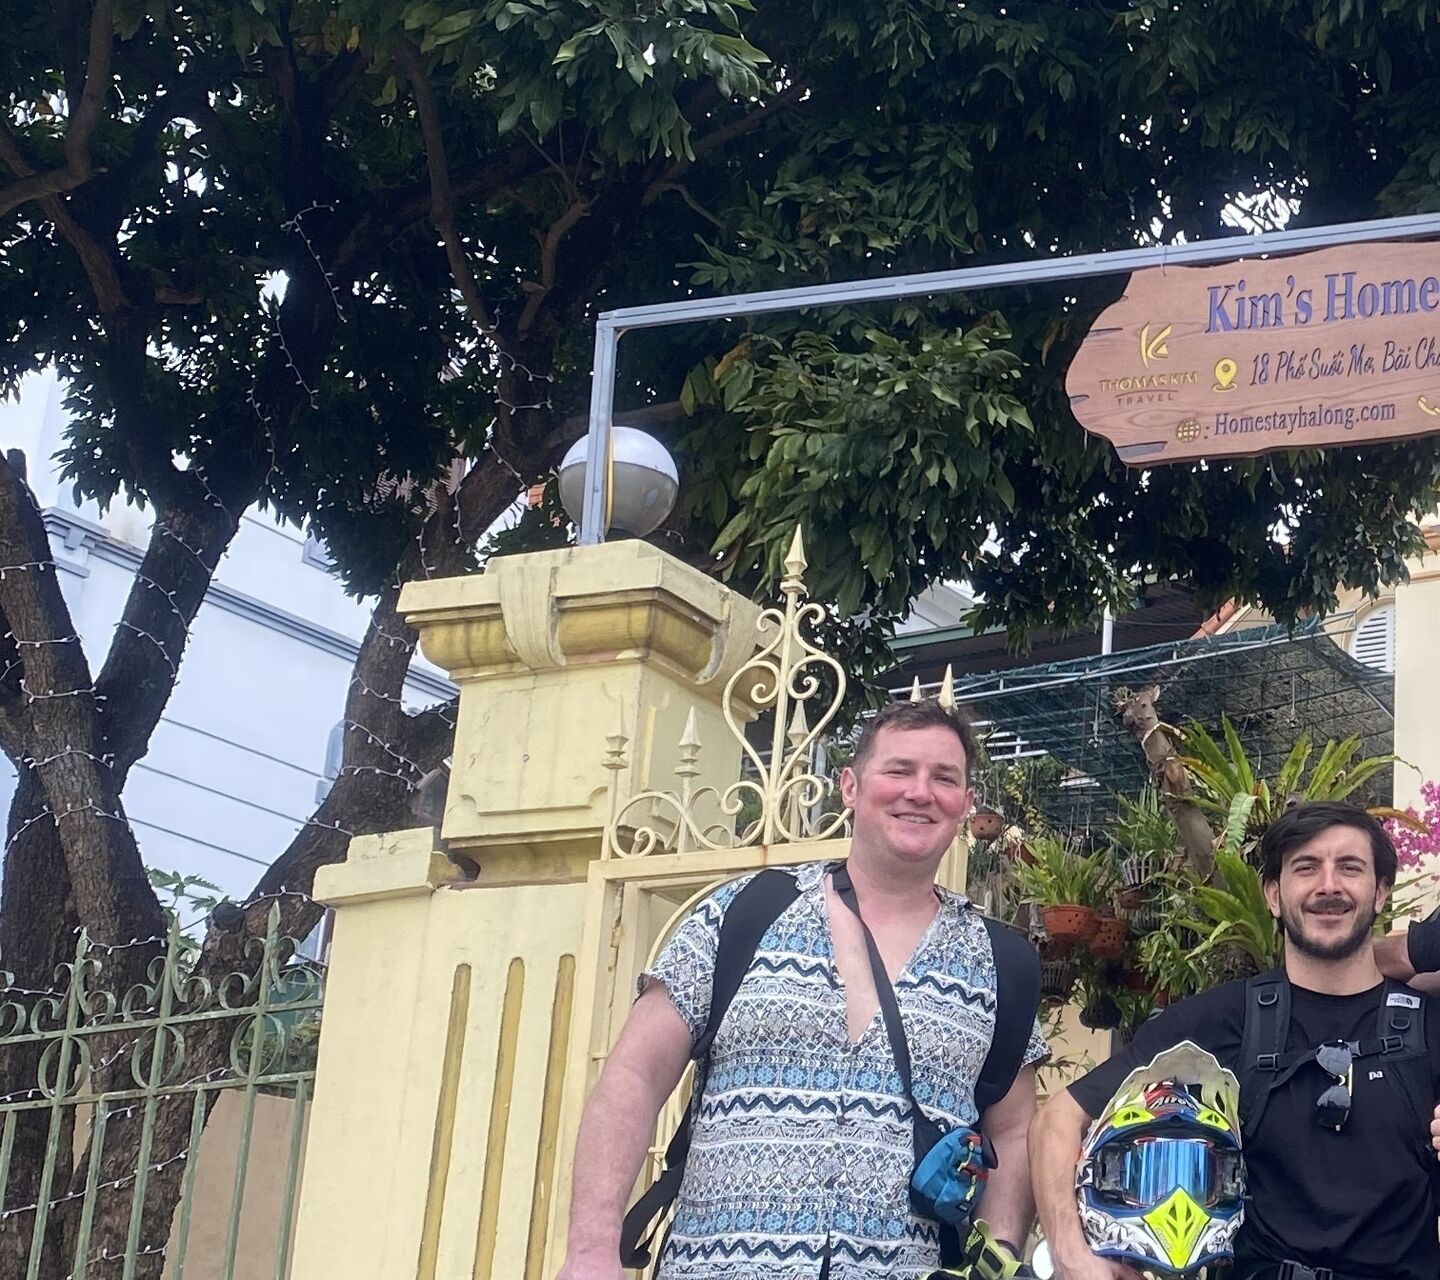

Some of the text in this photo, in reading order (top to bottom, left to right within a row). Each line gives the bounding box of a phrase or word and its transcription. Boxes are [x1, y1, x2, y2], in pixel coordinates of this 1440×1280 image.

[1205, 274, 1313, 333] Kim's
[1098, 371, 1198, 392] THOMAS KIM
[1249, 352, 1269, 386] 18
[1274, 350, 1308, 383] Phố
[1309, 348, 1345, 380] Suối
[1117, 392, 1174, 406] TRAVEL
[1214, 403, 1396, 436] Homestayhalong.com
